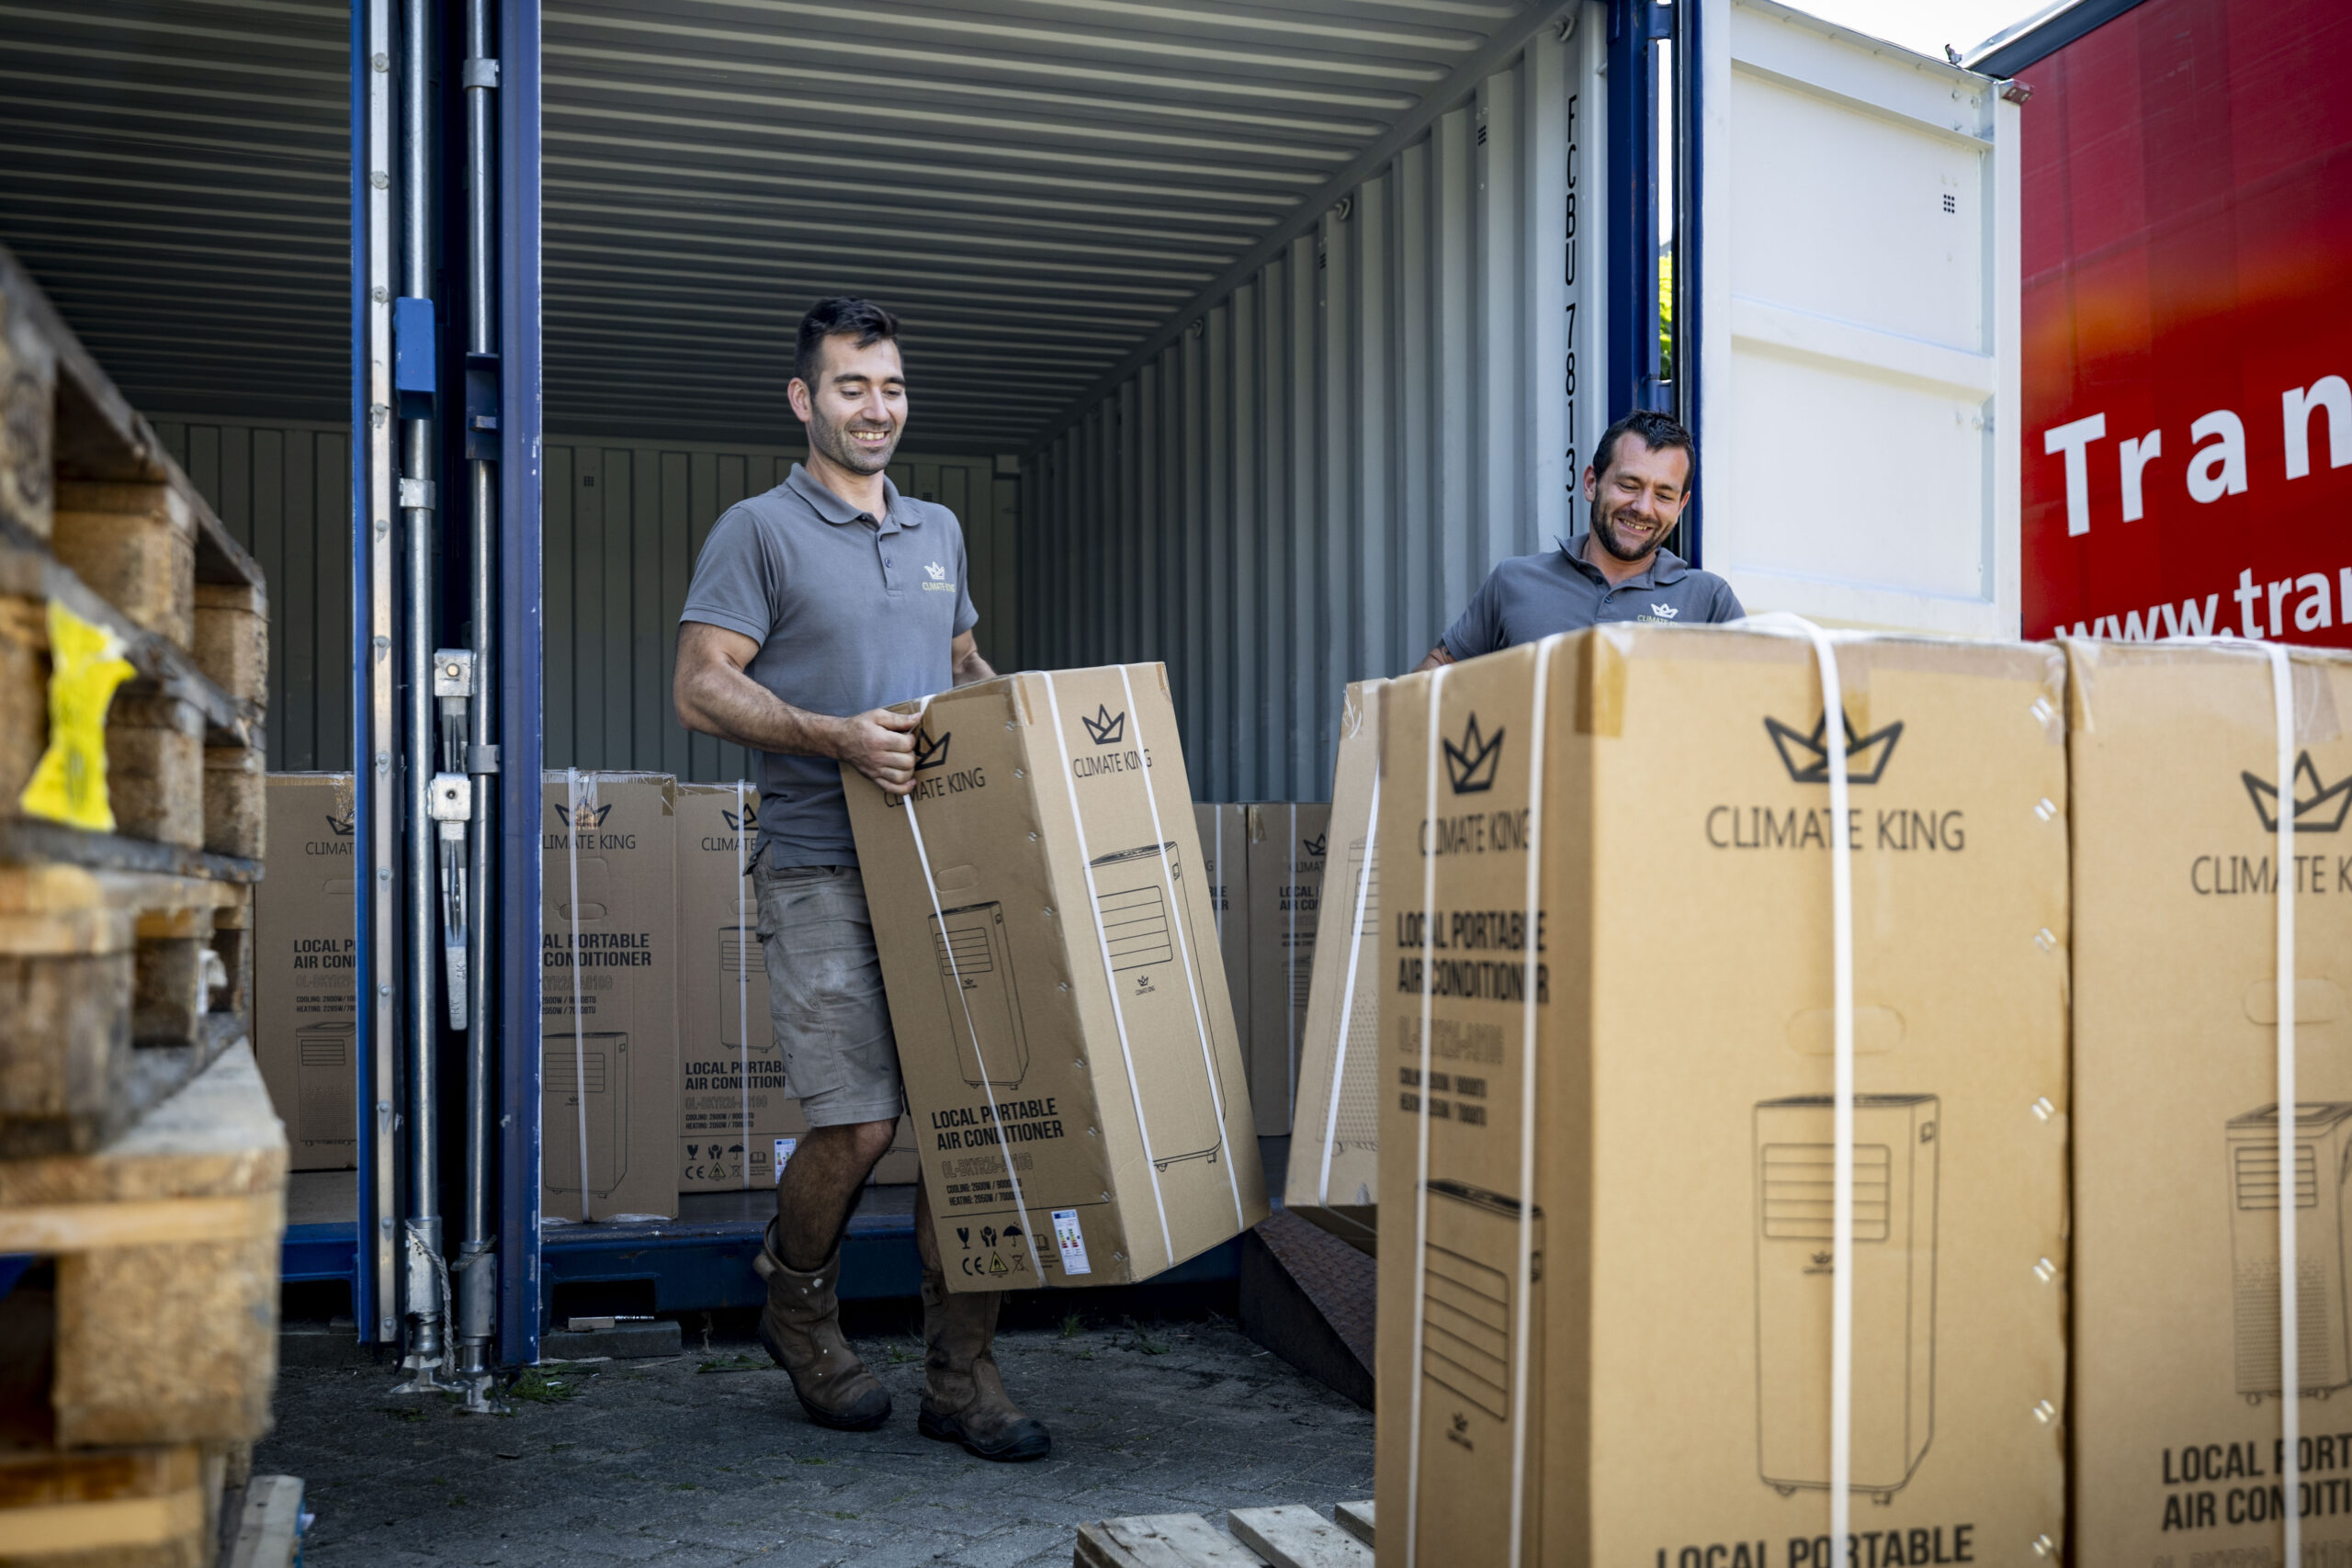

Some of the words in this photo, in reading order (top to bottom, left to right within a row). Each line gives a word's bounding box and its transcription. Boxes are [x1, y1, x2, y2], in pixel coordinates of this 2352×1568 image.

[1566, 94, 1577, 287] FCBU
[2043, 374, 2352, 538] Tran
[1072, 752, 1124, 779] CLIMATE
[883, 776, 946, 808] CLMATE
[946, 766, 987, 795] KING
[600, 834, 636, 850] KING
[1876, 808, 1965, 852] KING
[293, 939, 340, 953] LOCAL
[293, 956, 319, 969] AIR
[685, 1061, 729, 1076] LOCAL
[685, 1077, 708, 1090] AIR
[932, 1106, 979, 1130] LOCAL
[937, 1131, 962, 1151] AIR
[2162, 1440, 2265, 1485] LOCAL
[2162, 1491, 2217, 1532] AIR
